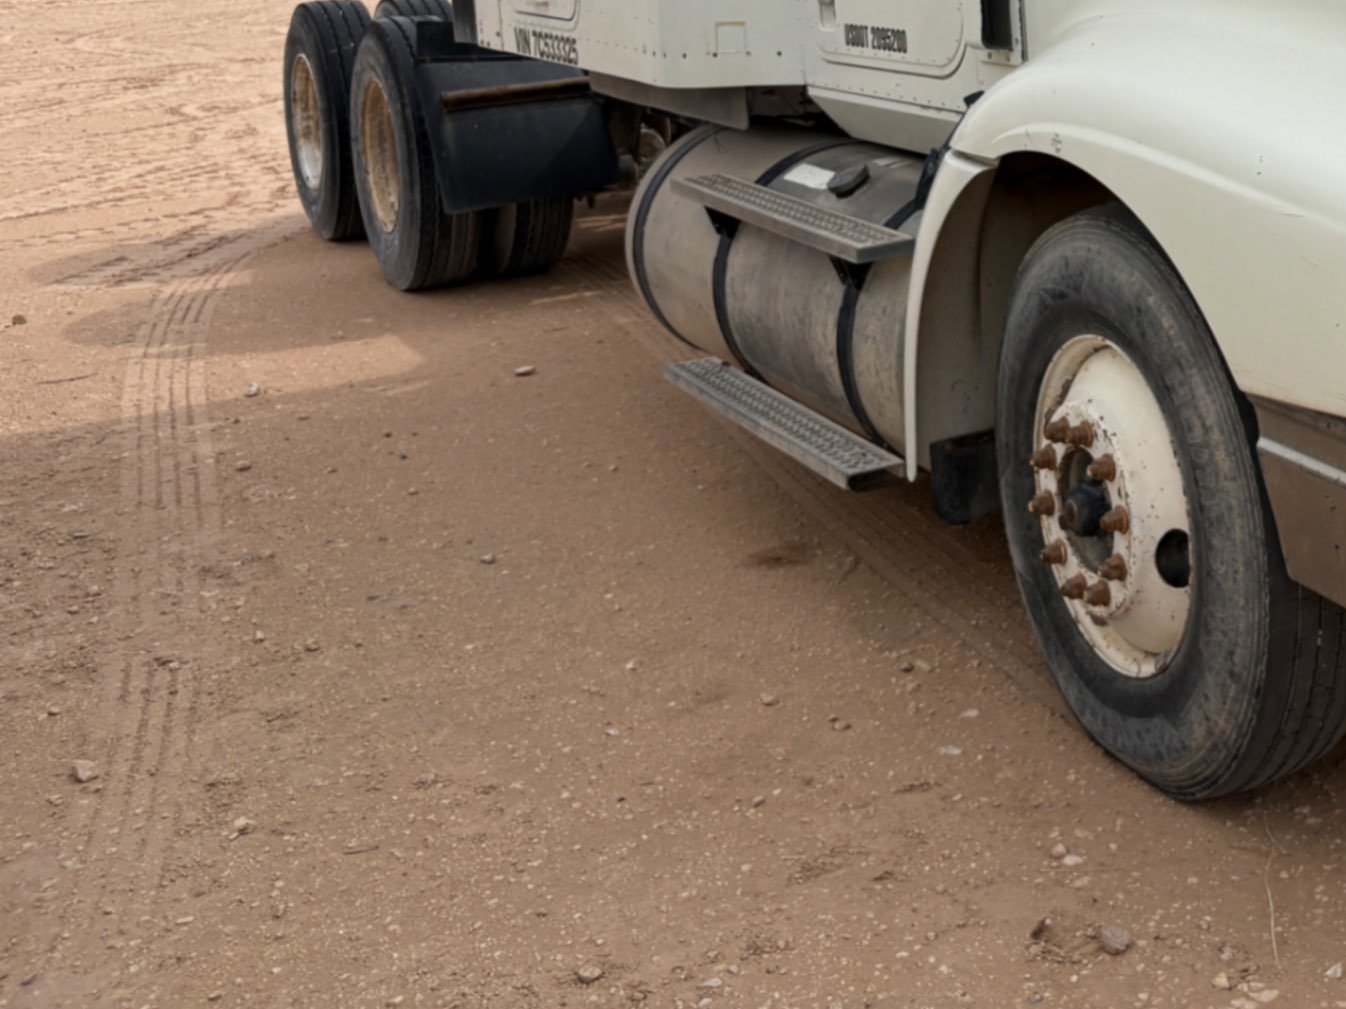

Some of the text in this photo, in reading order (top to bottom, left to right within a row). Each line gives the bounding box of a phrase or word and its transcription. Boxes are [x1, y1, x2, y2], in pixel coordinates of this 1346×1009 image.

[514, 26, 578, 65] VIN 7C533325
[844, 24, 869, 48] USDOT
